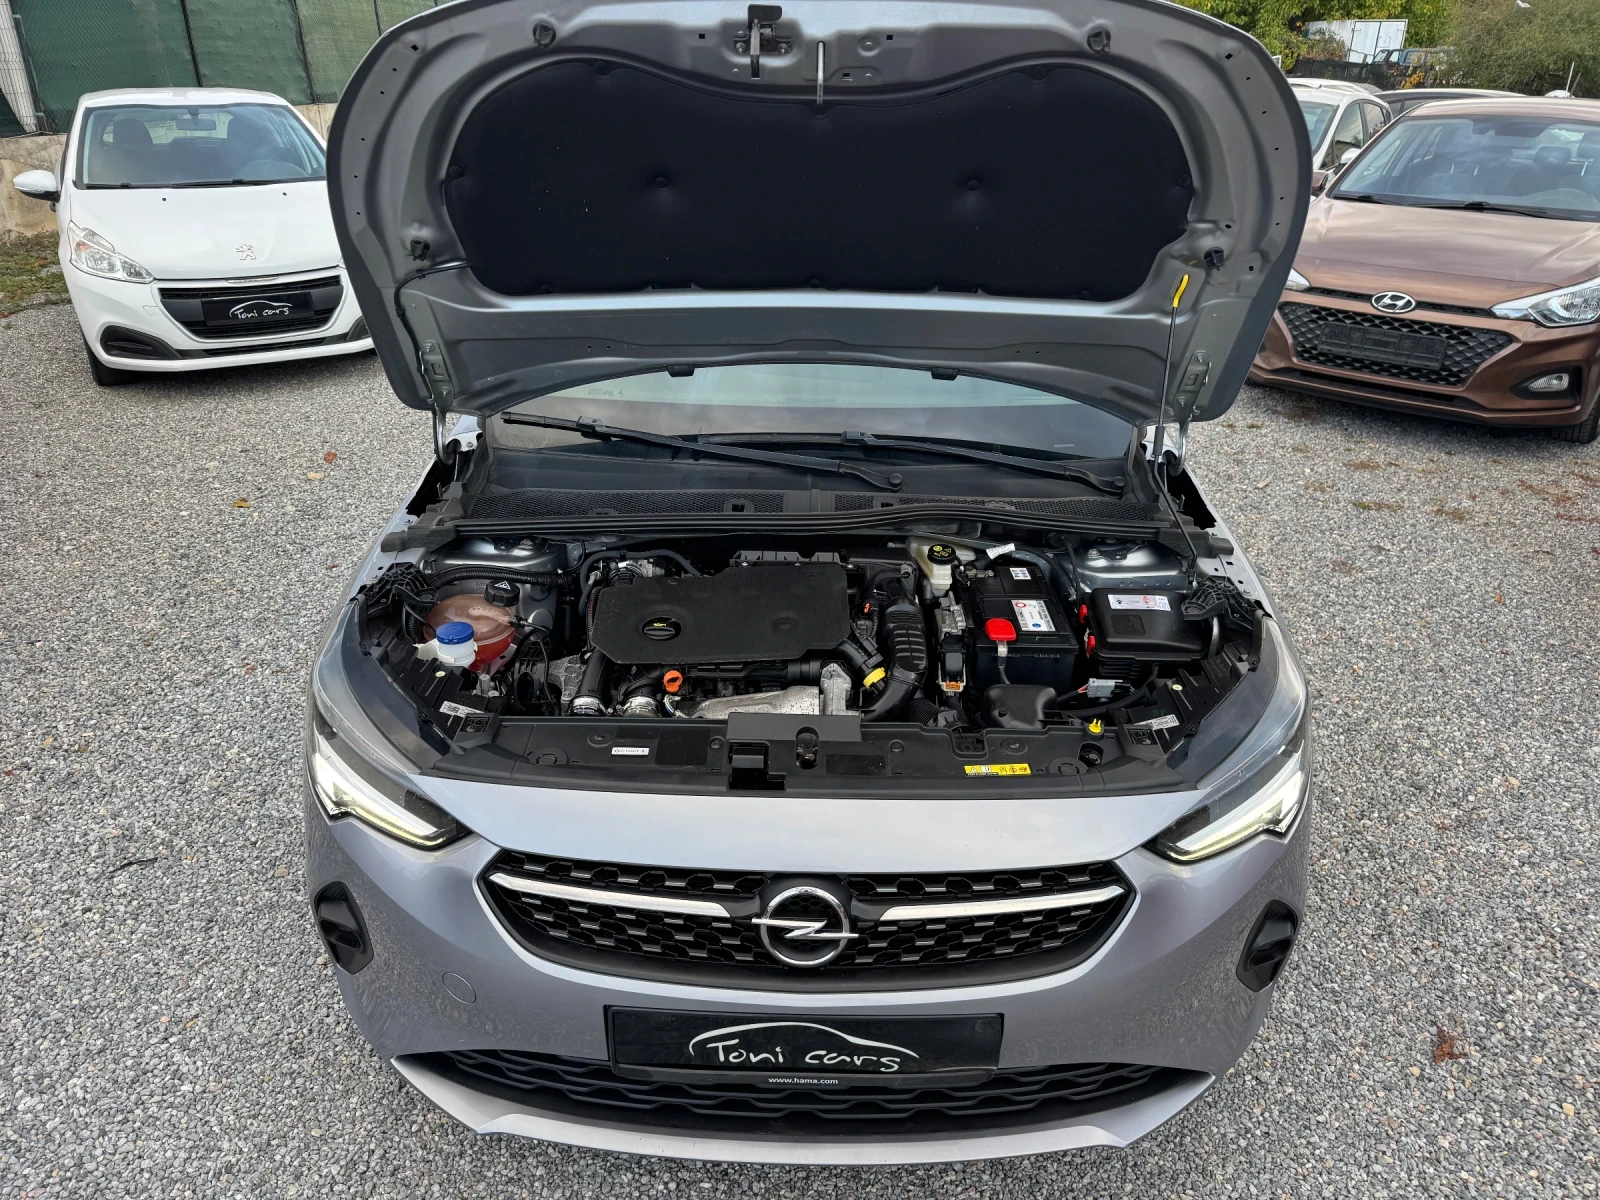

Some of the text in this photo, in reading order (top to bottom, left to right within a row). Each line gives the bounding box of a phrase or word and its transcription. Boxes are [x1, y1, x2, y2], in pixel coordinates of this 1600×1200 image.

[234, 307, 289, 319] Toni cars
[706, 1038, 901, 1072] Toni cars
[768, 1077, 839, 1085] www.hama.com
